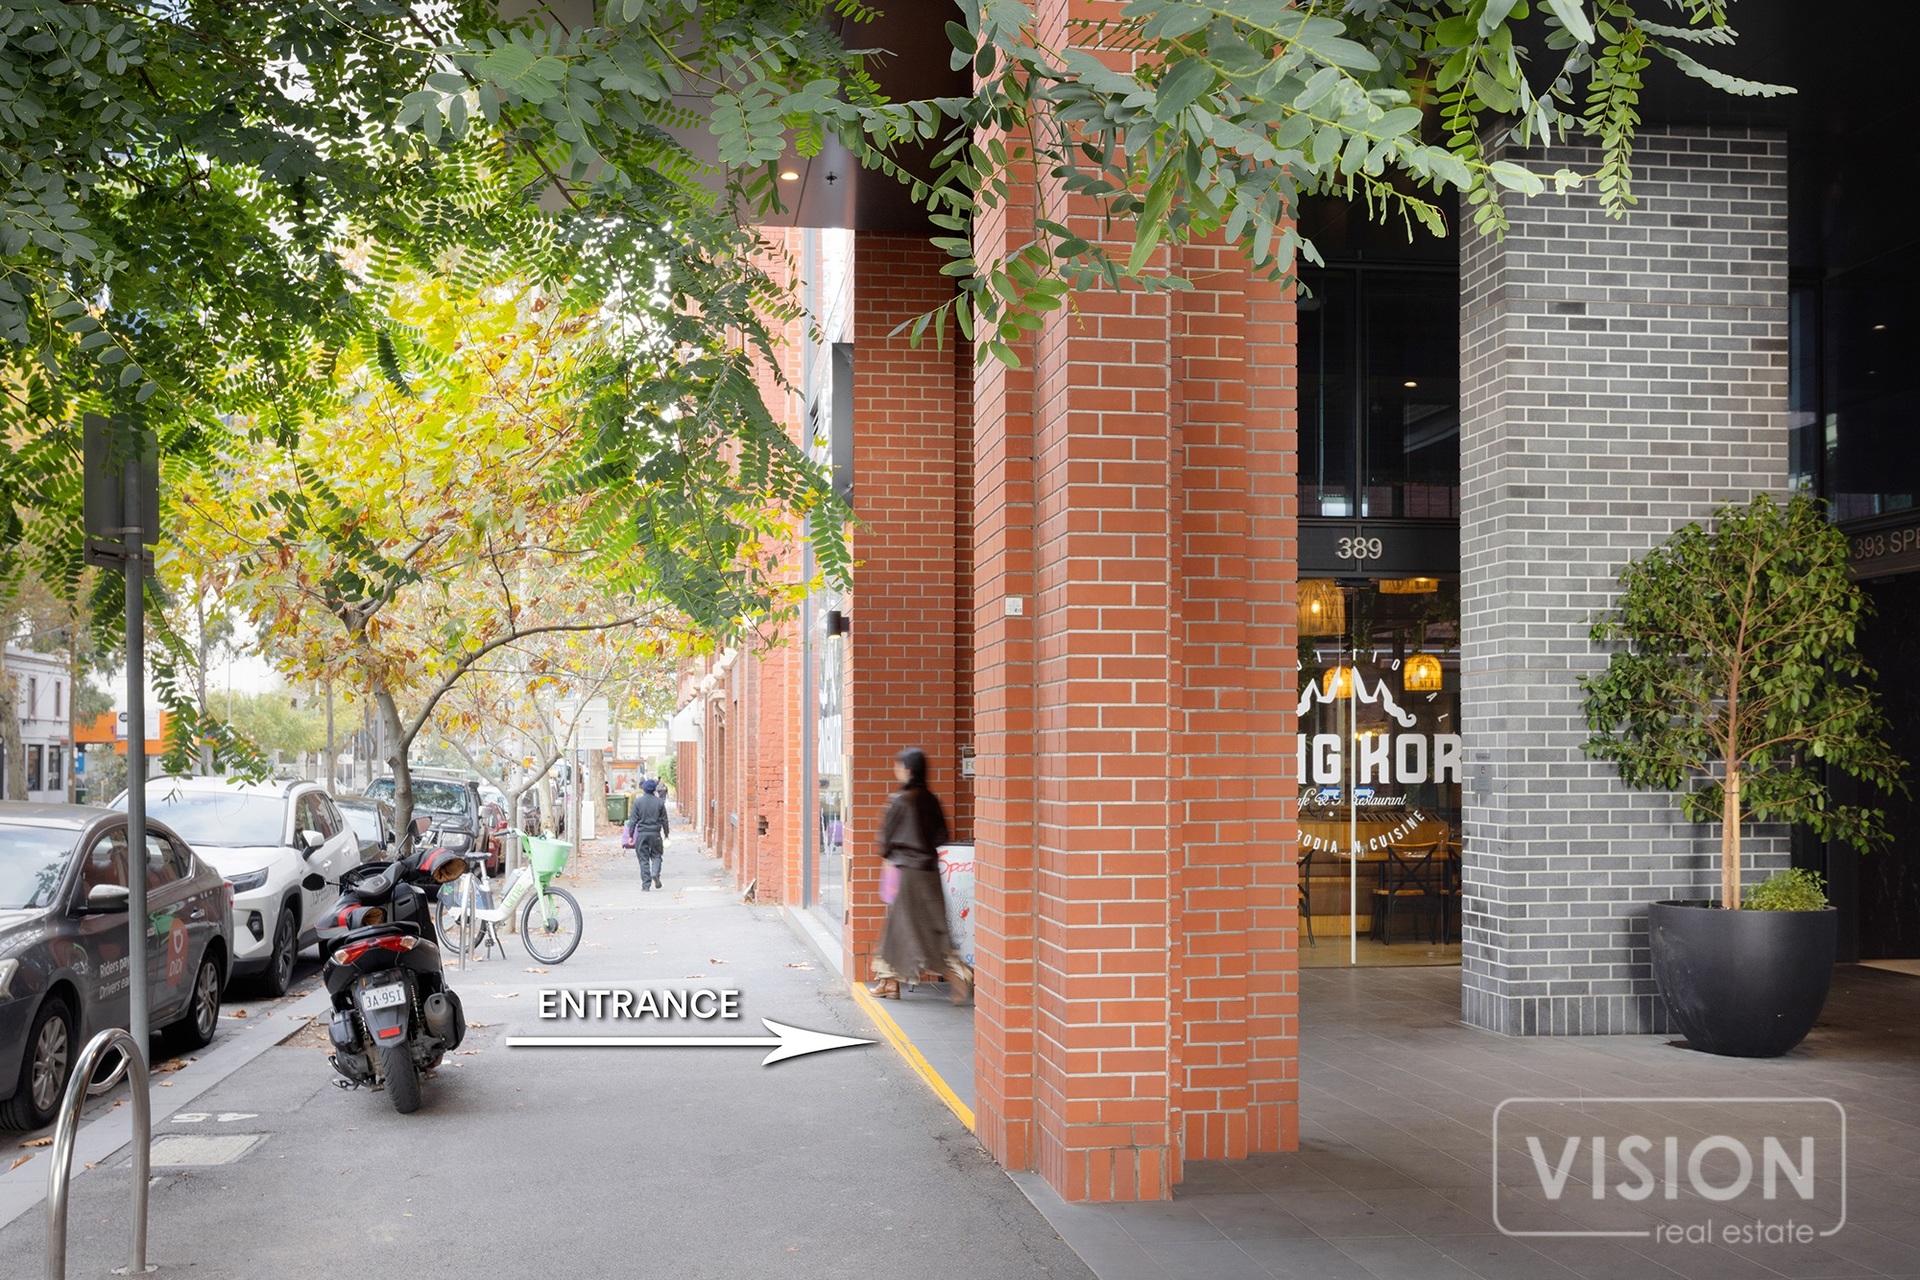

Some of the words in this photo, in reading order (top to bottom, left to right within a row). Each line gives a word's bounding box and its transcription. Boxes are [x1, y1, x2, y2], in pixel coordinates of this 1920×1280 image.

[1335, 537, 1382, 559] 389
[1855, 534, 1885, 559] 393
[1369, 810, 1425, 851] CUISINE
[100, 960, 119, 979] Riders
[100, 980, 120, 1000] Drivers
